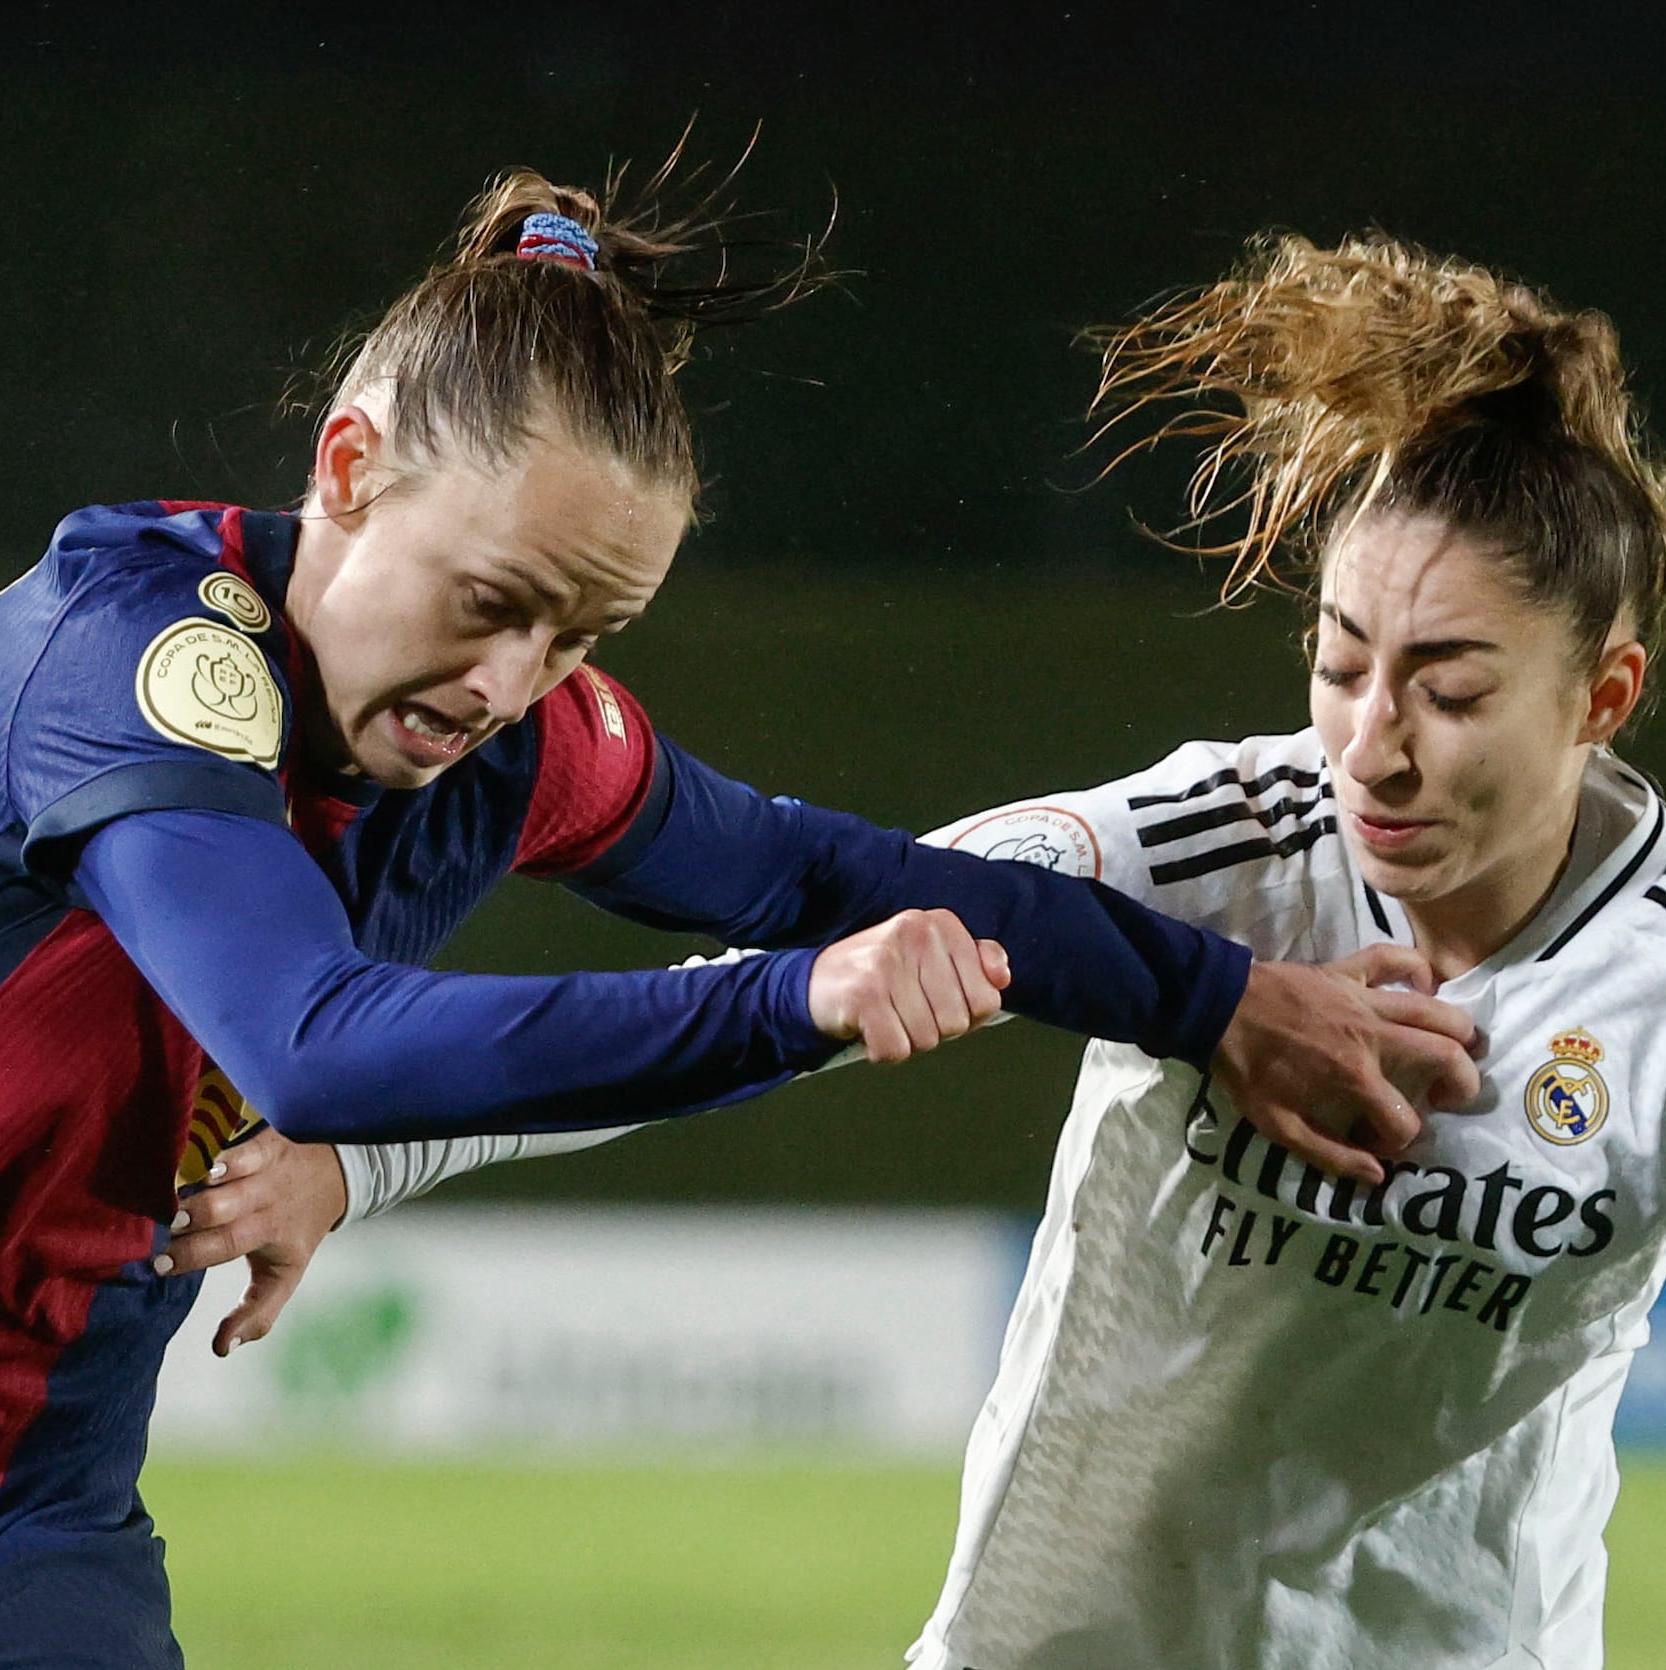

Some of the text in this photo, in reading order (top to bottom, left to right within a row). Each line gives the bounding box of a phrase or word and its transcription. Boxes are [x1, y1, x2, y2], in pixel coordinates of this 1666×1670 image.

[221, 586, 255, 614] 10
[157, 643, 186, 679] COPA
[186, 632, 209, 646] DE
[1004, 814, 1049, 826] COPA
[1052, 818, 1073, 832] DE
[1201, 1194, 1533, 1332] FLY BETTER
